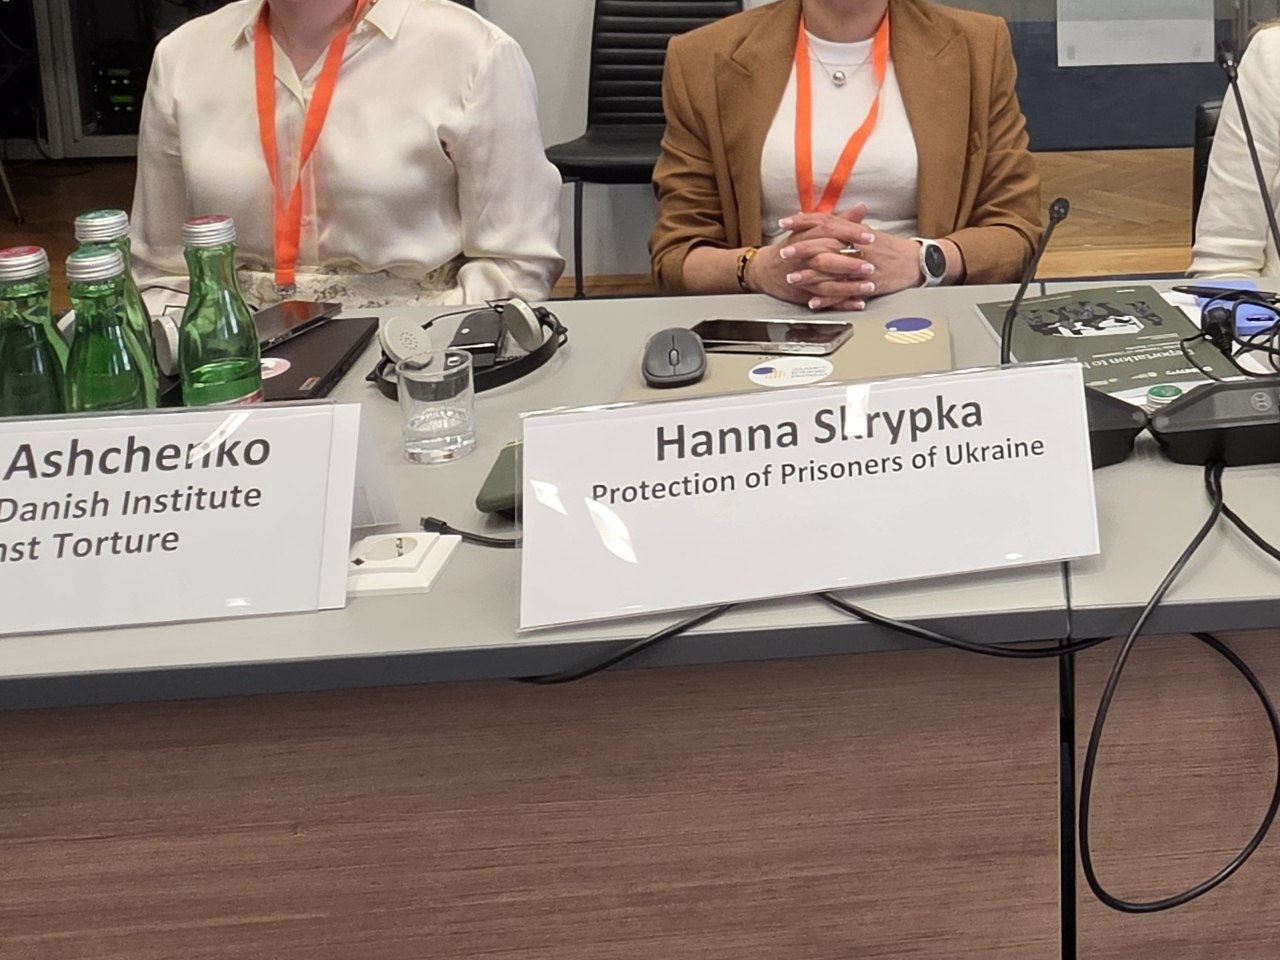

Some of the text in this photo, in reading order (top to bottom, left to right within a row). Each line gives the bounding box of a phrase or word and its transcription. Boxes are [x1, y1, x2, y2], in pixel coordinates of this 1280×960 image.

[656, 421, 798, 461] Hanna
[592, 438, 1045, 504] Protection of Prisoners of Ukraine
[0, 485, 262, 523] Danish Institute
[52, 530, 180, 559] Torture
